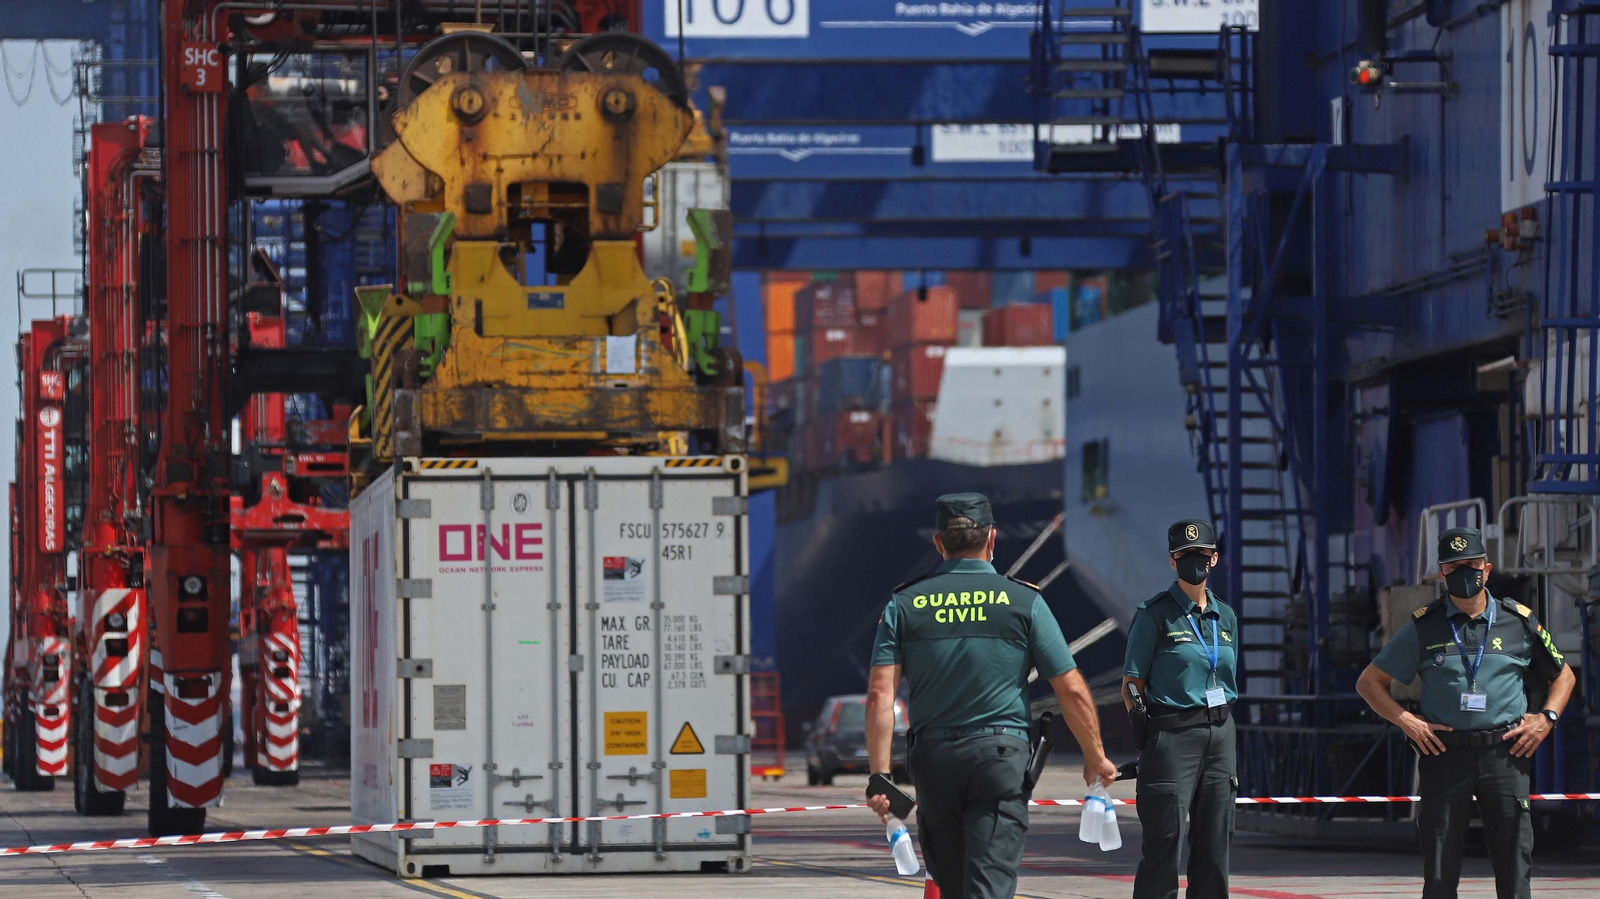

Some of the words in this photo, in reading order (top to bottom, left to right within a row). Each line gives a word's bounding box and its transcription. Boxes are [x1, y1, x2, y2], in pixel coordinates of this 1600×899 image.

[184, 47, 218, 67] SHC
[195, 67, 206, 87] 3
[44, 428, 56, 460] TTI
[44, 463, 56, 551] ALGECIRAS
[620, 523, 651, 539] FSCU
[662, 522, 709, 538] 575627
[716, 522, 724, 538] 9
[438, 523, 543, 562] ONE
[662, 545, 692, 560] 45R1
[912, 590, 1011, 609] GUARDIA
[934, 607, 987, 623] CIVIL
[689, 624, 702, 632] LBS
[601, 635, 629, 650] TARE
[689, 643, 703, 651] LBS
[601, 653, 649, 669] PAYLOAD
[690, 662, 703, 670] LBS
